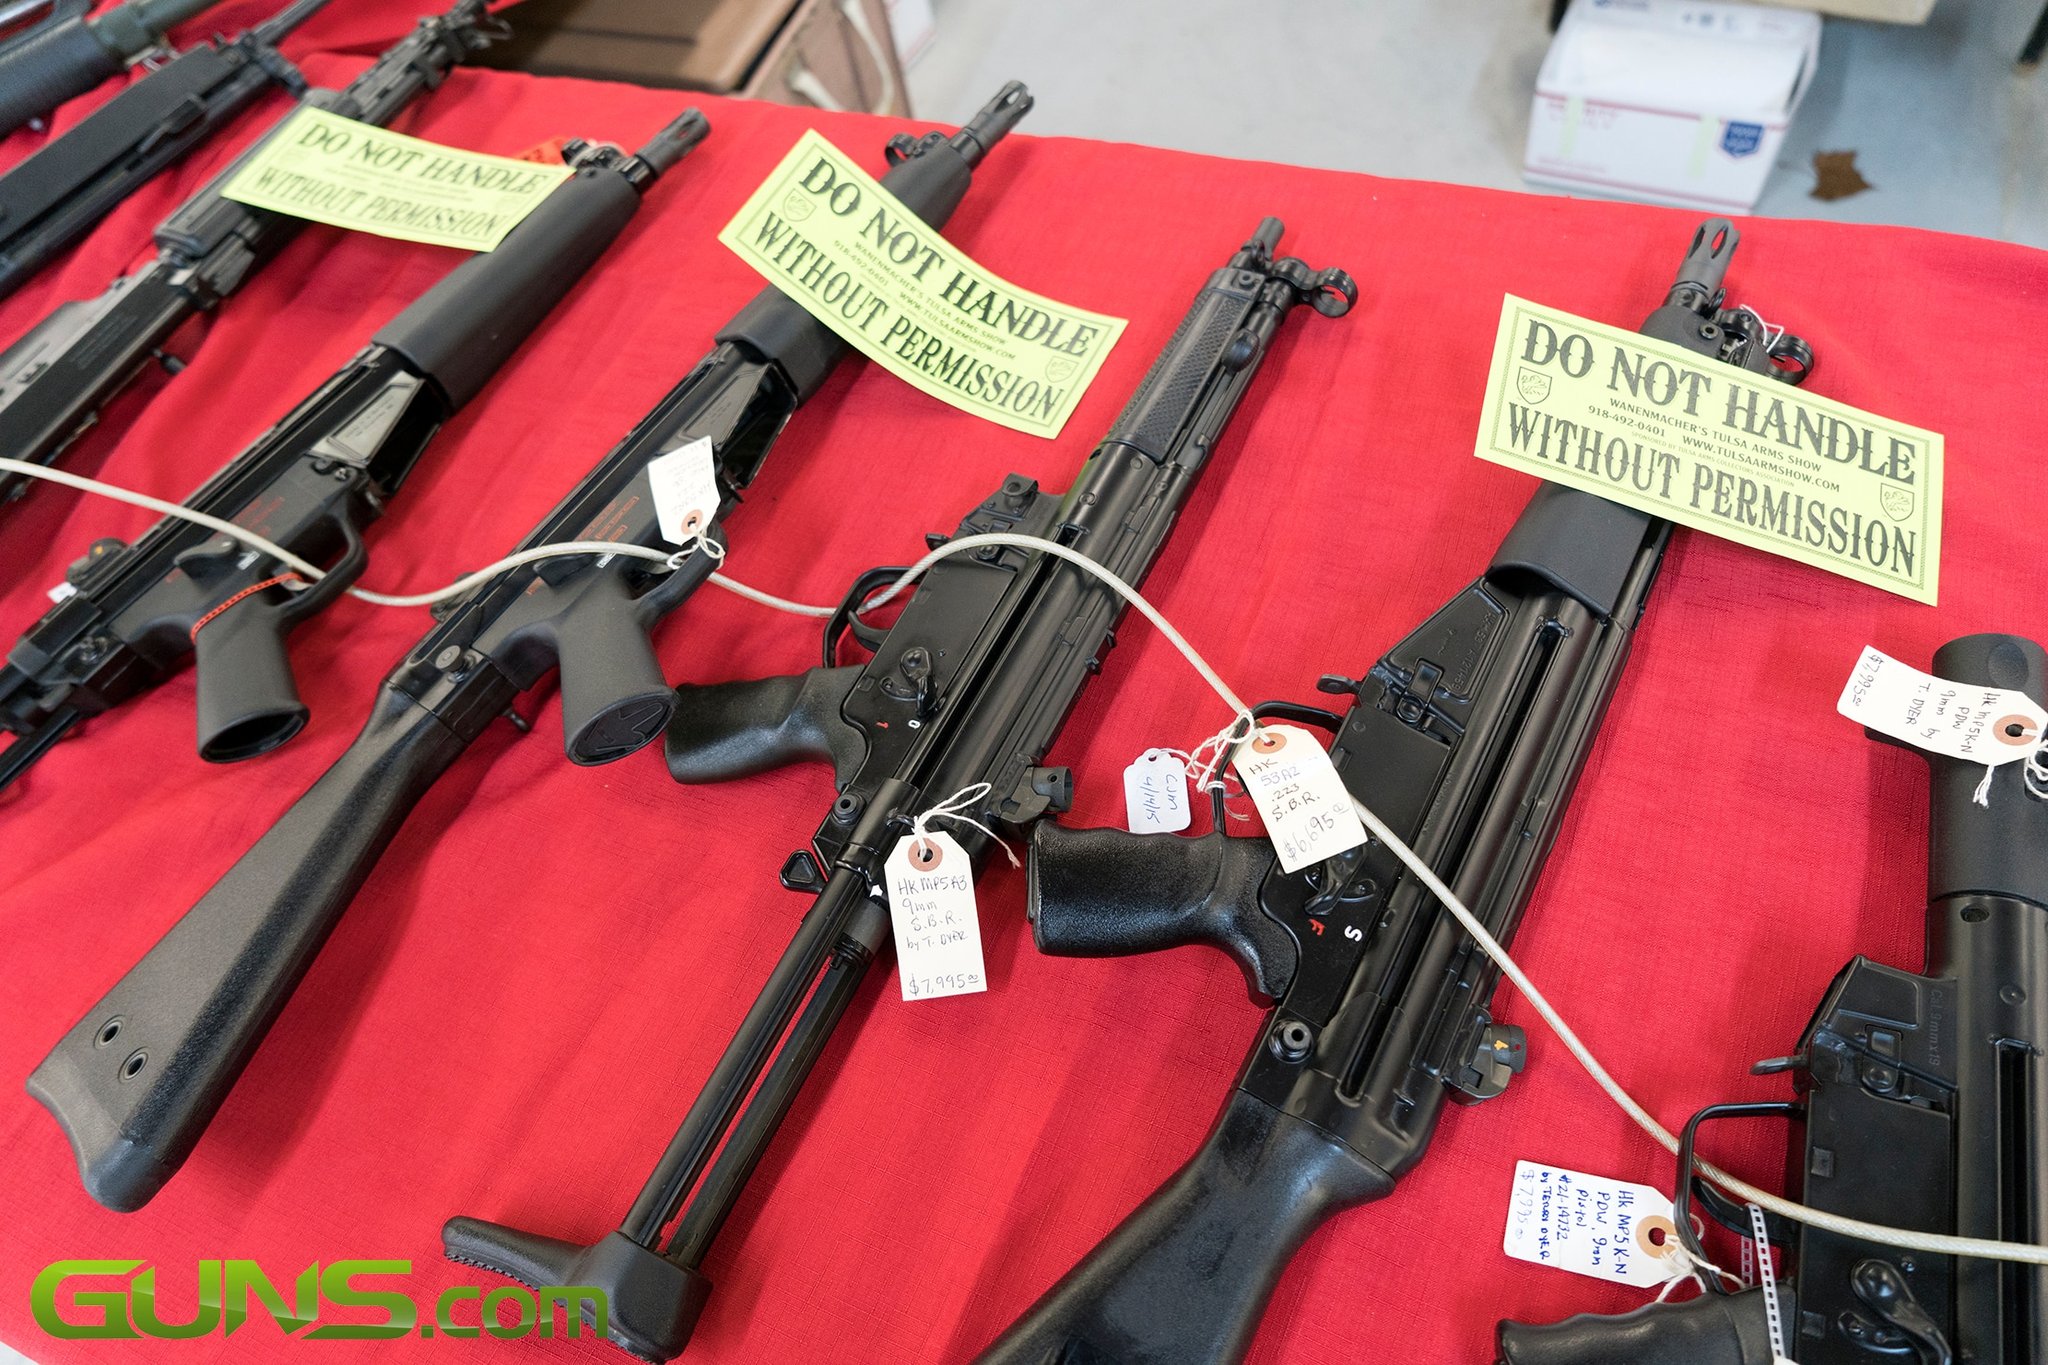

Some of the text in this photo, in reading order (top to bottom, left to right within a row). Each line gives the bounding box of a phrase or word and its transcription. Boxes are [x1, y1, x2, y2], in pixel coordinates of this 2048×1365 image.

[298, 122, 351, 154] DO
[352, 138, 421, 174] NOT
[418, 157, 550, 196] HANDLE
[254, 166, 369, 217] WITHOUT
[358, 196, 507, 239] PERMISSION
[798, 156, 861, 217] DO
[859, 207, 946, 283] NOT
[938, 269, 1099, 359] HANDLE
[833, 239, 889, 287] 918-492-0401
[899, 291, 1017, 361] WWW.TULSAARMSHOW.COM
[854, 241, 1008, 346] WANENMACHER'S TULSA ARMS SHOW
[754, 210, 890, 332] WITHOUT
[879, 314, 1065, 421] PERMISSION
[1520, 318, 1917, 487] DO NOT HANDLE
[1588, 404, 1841, 493] 918-492-0401 WWW.TULSAARMSHOW.COM
[1609, 397, 1822, 473] WANENMACHER'S TULSA ARMS SHOW
[1631, 431, 1667, 447] SPONSORED
[1678, 445, 1697, 457] TULSA
[1698, 452, 1716, 463] ARMS
[1716, 457, 1755, 475] COLLECTORS
[1755, 471, 1795, 488] ASSOCIATION
[1508, 401, 1917, 578] WITHOUT PERMISSION
[1905, 698, 1925, 726] DYER
[1920, 689, 1957, 740] 9mm by
[1952, 706, 1971, 730] PDW
[1248, 757, 1280, 775] HK
[1271, 782, 1300, 802] .223
[1271, 792, 1321, 822] S.B.R.
[897, 877, 919, 896] HK
[902, 897, 938, 915] 9mm
[906, 936, 920, 952] by
[939, 930, 969, 946] DYER
[910, 909, 963, 932] S.B.R.
[1344, 925, 1363, 943] S
[1540, 1171, 1549, 1183] by
[1538, 1227, 1551, 1261] DYER
